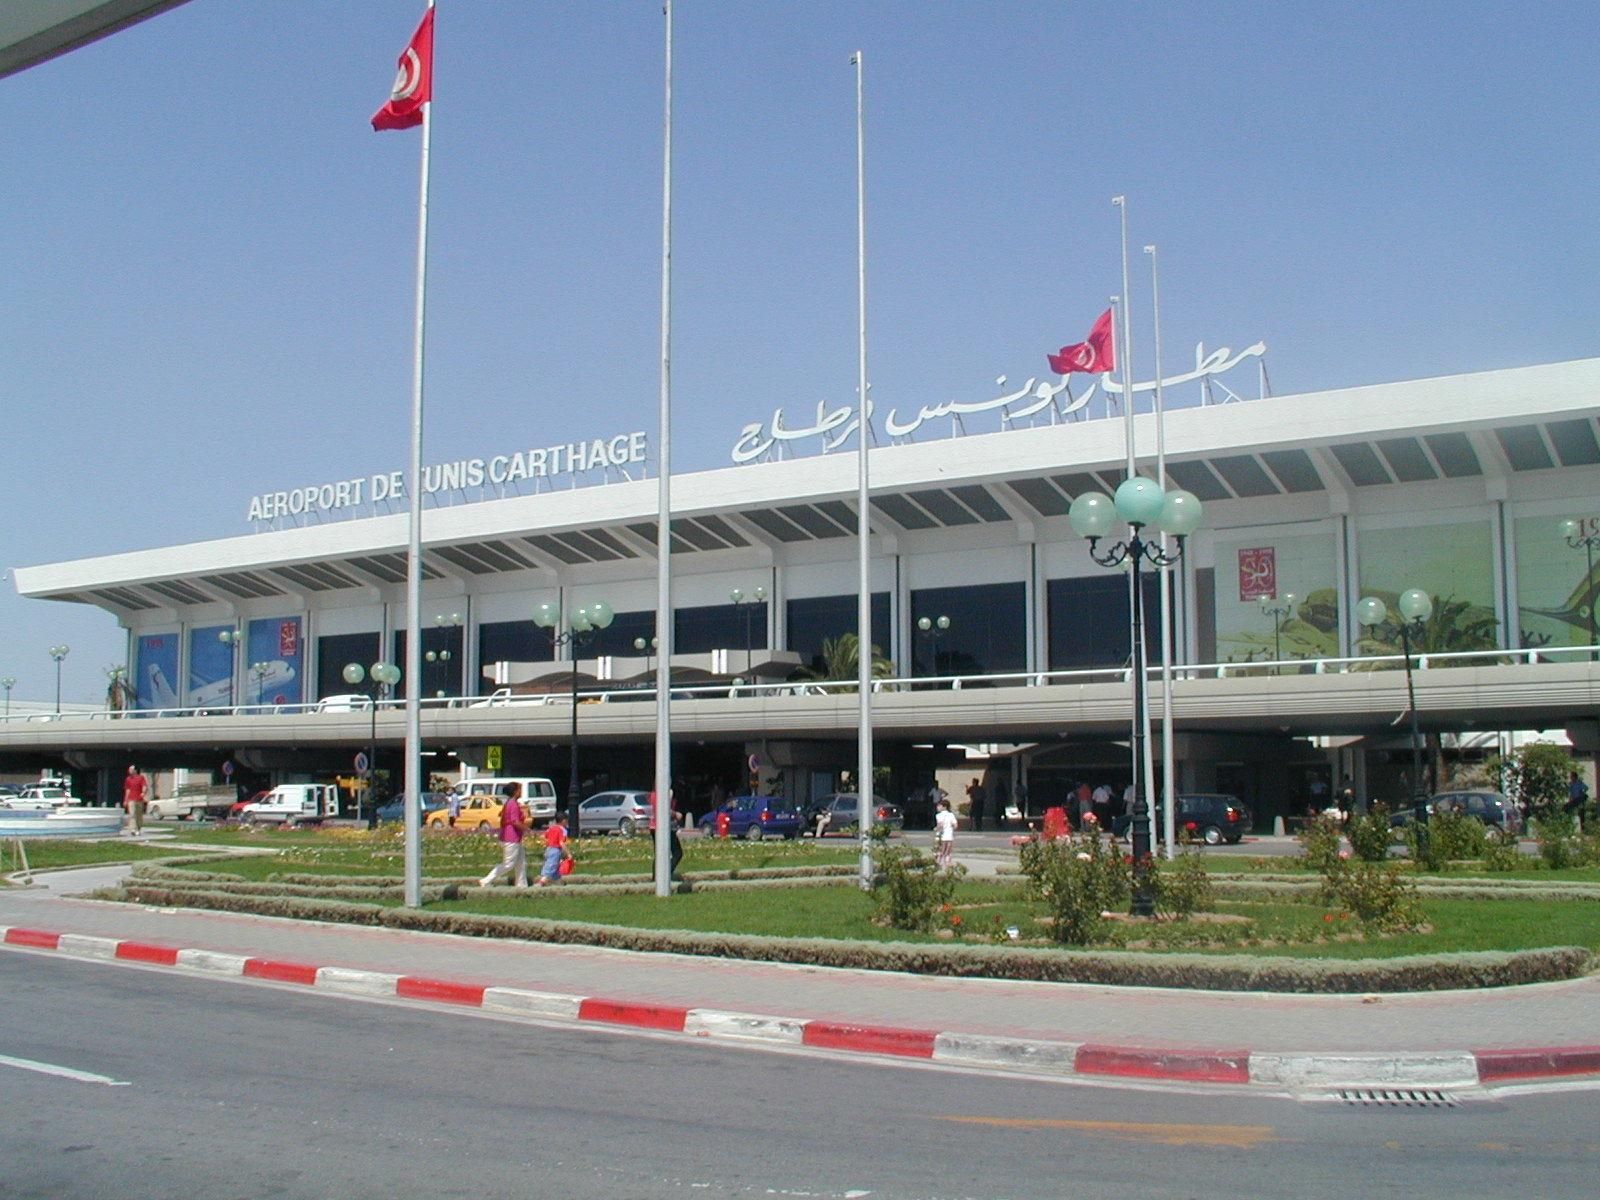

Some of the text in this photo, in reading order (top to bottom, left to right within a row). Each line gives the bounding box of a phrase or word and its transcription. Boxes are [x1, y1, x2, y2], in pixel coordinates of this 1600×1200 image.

[247, 431, 646, 521] AEROPORT DE UNIS CARTHAGE
